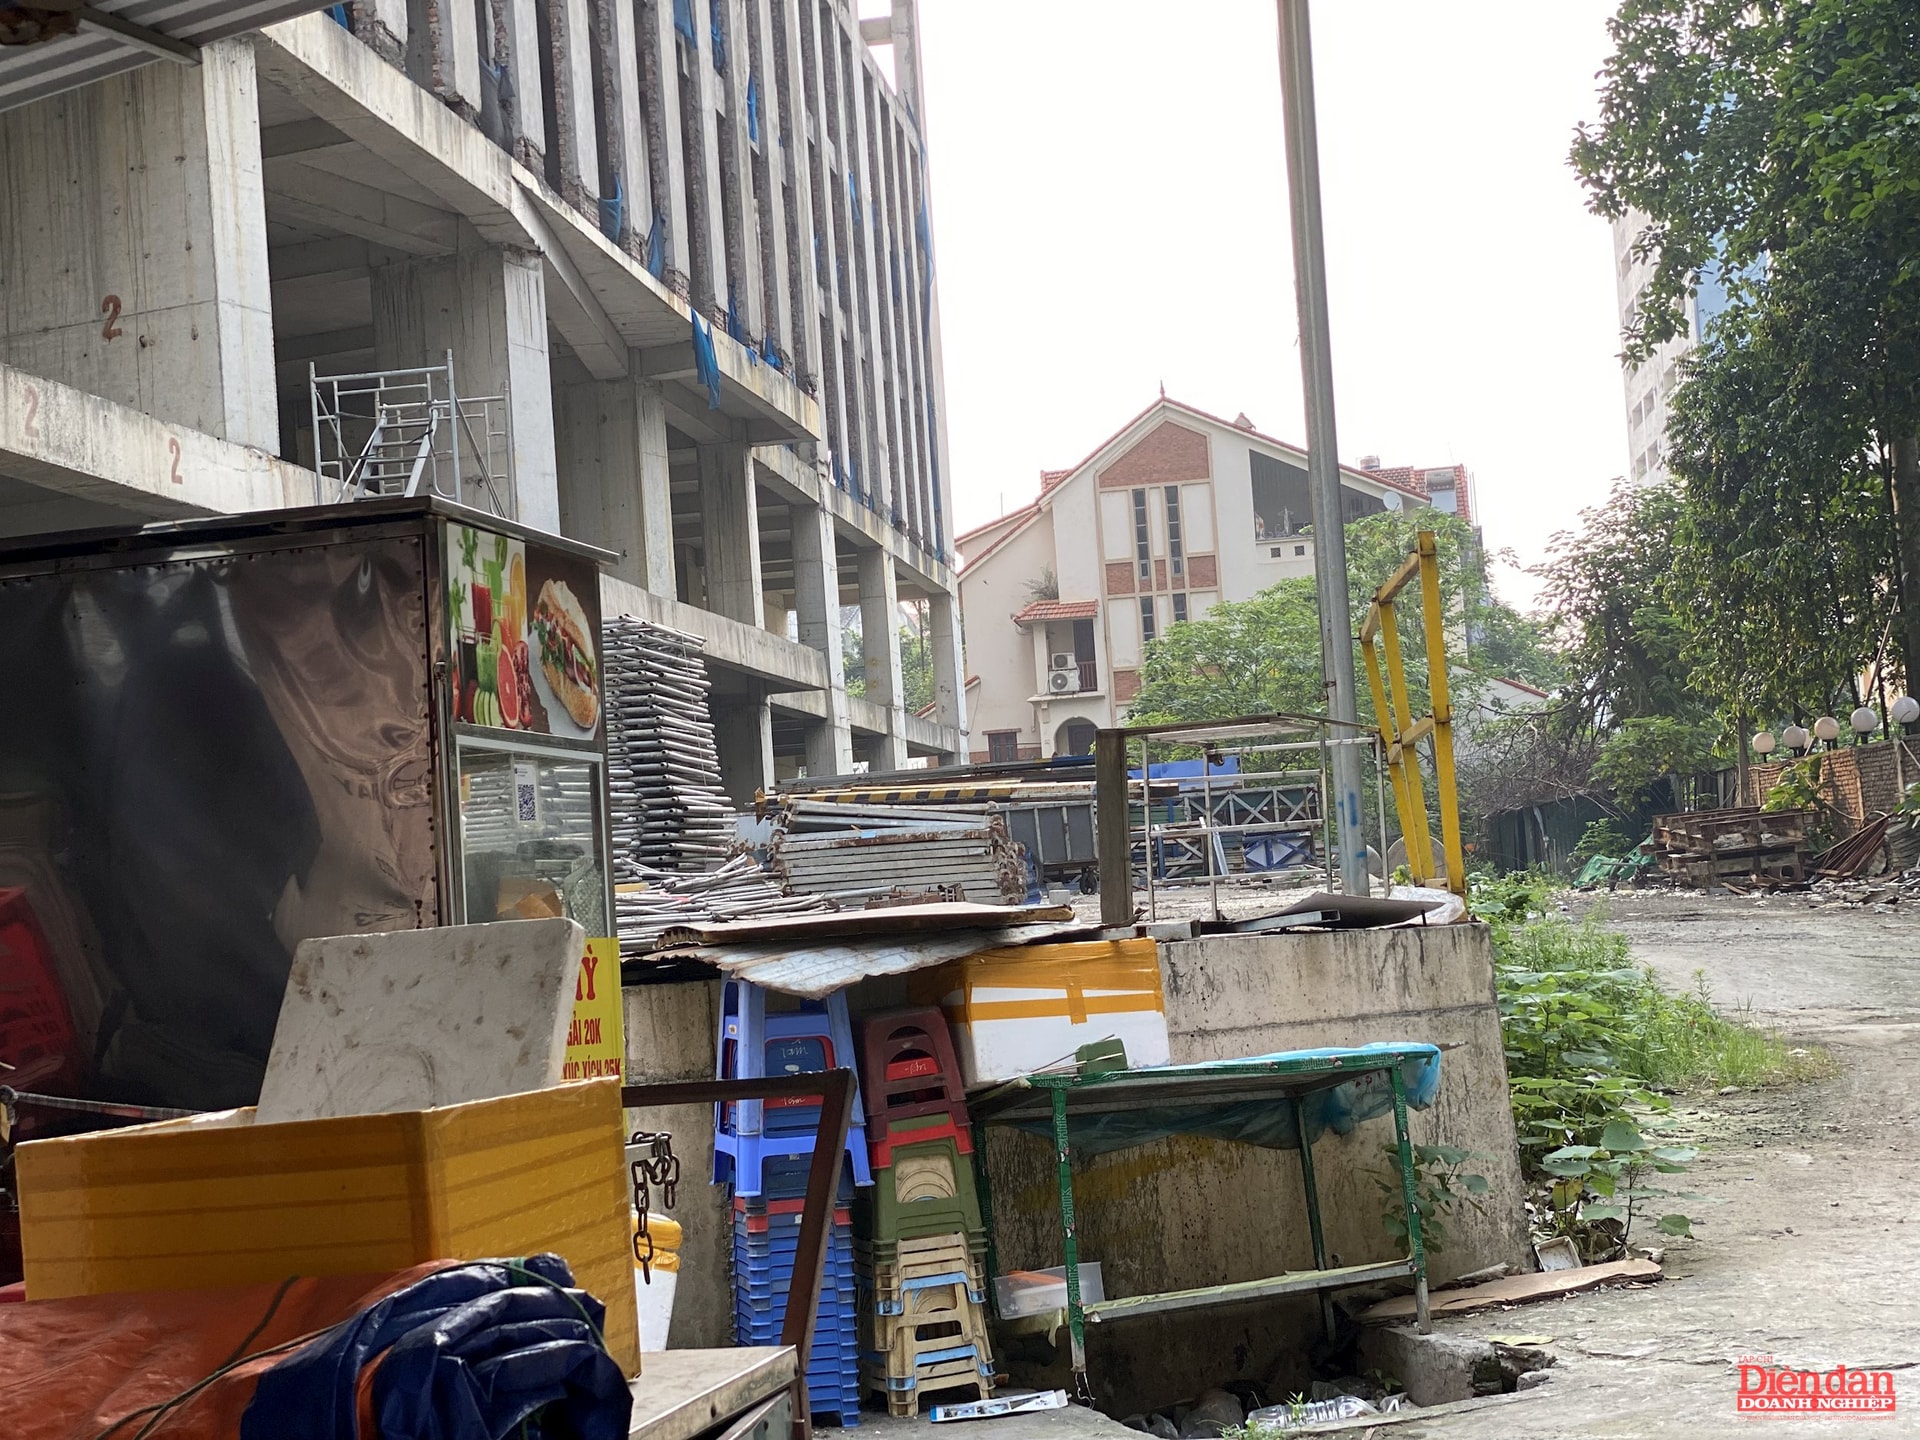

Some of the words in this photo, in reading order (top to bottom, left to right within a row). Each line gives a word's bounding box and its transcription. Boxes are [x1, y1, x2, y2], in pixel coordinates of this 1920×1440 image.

[102, 294, 122, 341] 2
[24, 385, 39, 438] 2
[168, 437, 183, 484] 2
[584, 1017, 602, 1045] 20K
